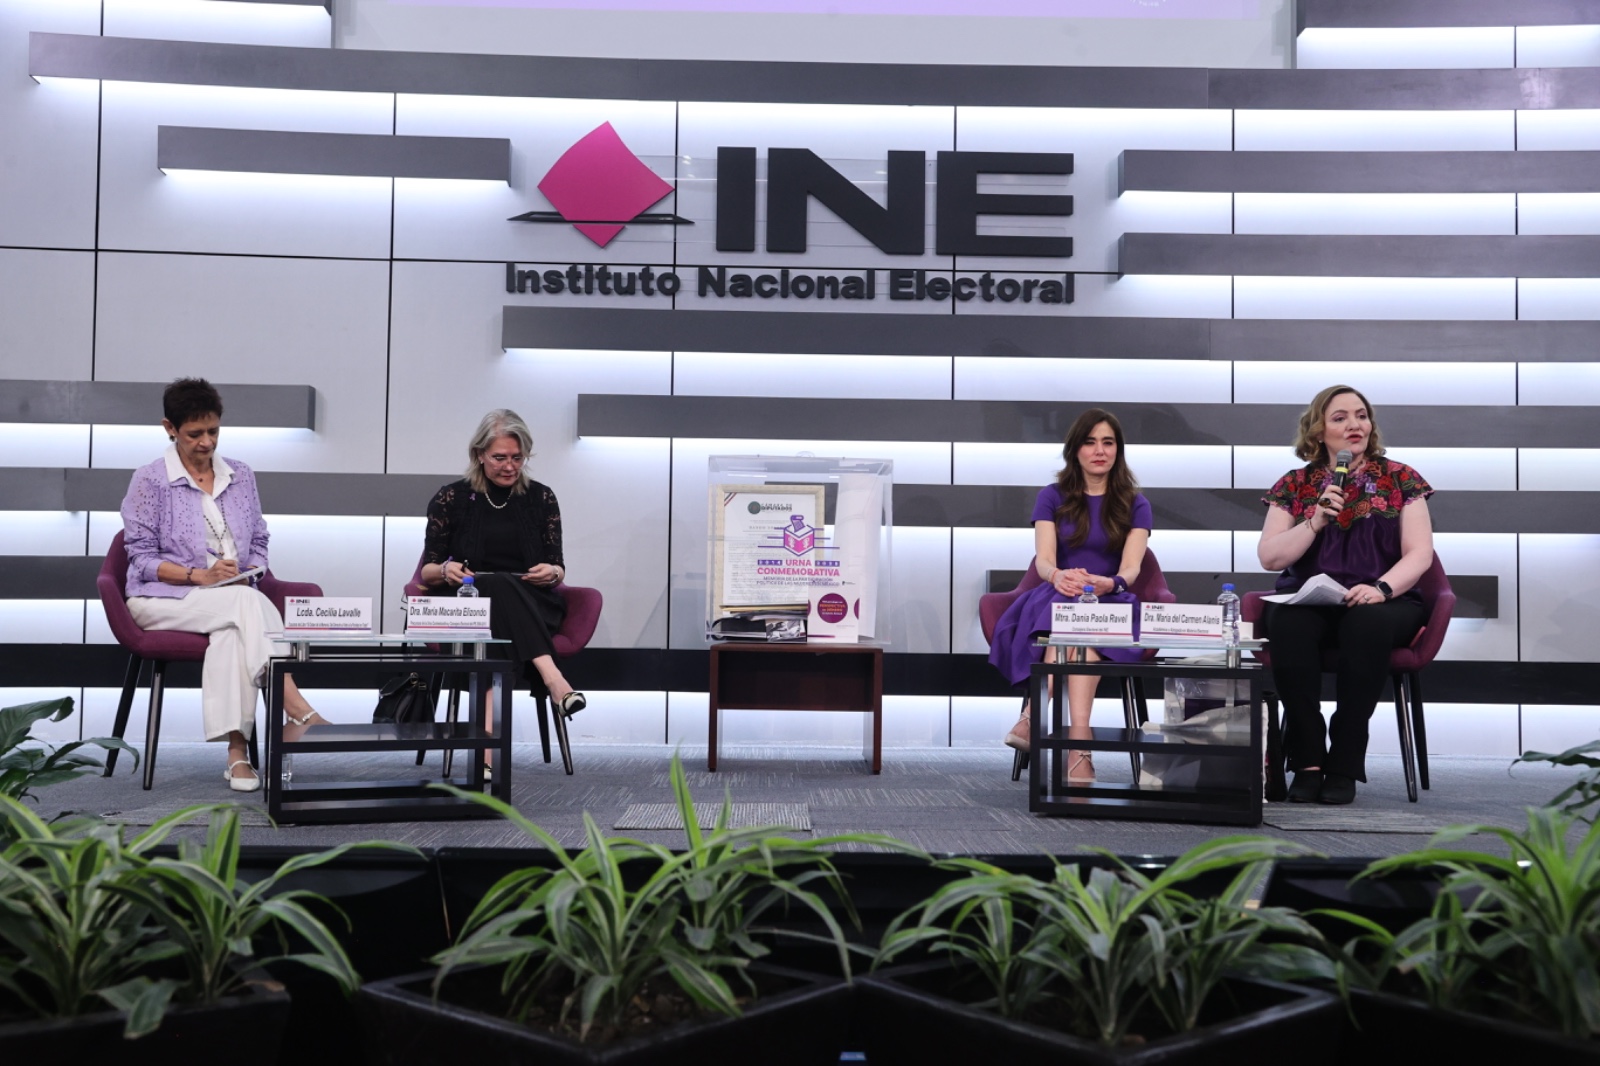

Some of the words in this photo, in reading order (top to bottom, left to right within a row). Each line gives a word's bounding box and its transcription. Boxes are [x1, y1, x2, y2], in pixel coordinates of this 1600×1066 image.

[716, 146, 1074, 256] INE
[506, 262, 681, 296] Instituto
[699, 267, 876, 301] Nacional
[889, 270, 1075, 305] Electoral
[785, 559, 812, 567] URNA
[757, 567, 840, 576] CONMEMORATIVA
[296, 607, 314, 617] Lcda.
[315, 607, 337, 617] Cecilia
[338, 608, 361, 618] Lavalle
[410, 606, 422, 616] Dra.
[462, 607, 487, 617] Elizondo
[1055, 613, 1070, 623] Mtra.
[1071, 613, 1090, 623] Dania
[1090, 613, 1108, 623] Paola
[1109, 614, 1128, 624] Ravel
[1144, 612, 1155, 622] Dra.
[1172, 613, 1181, 623] del
[1181, 614, 1202, 624] Carmen
